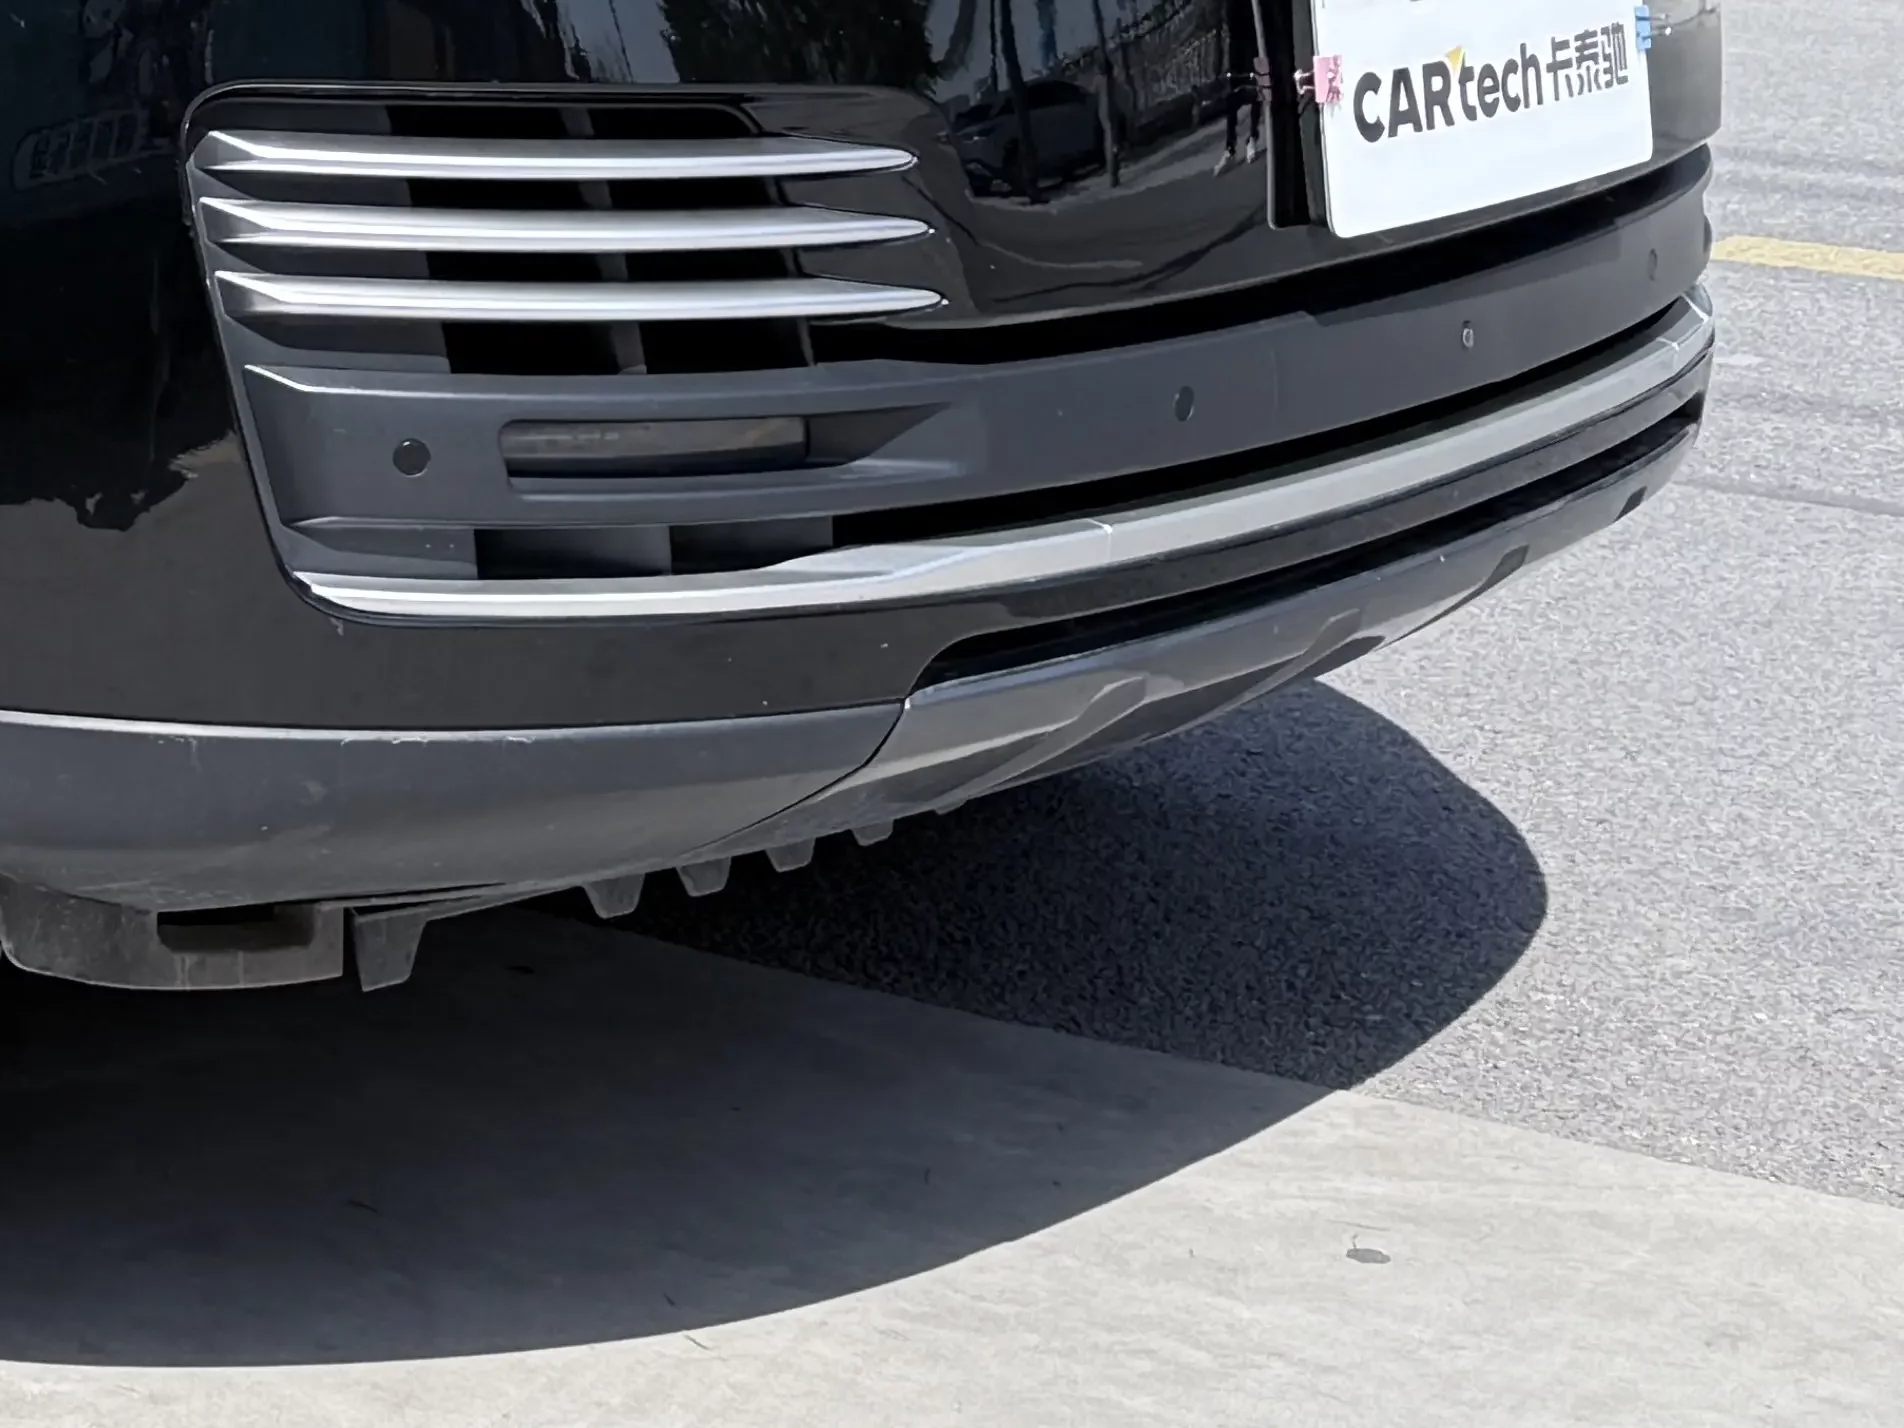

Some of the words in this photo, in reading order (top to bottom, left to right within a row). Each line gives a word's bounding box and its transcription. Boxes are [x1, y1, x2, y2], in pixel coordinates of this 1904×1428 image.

[1353, 42, 1543, 143] CARtech
[1546, 22, 1629, 101] 卡泰驰
